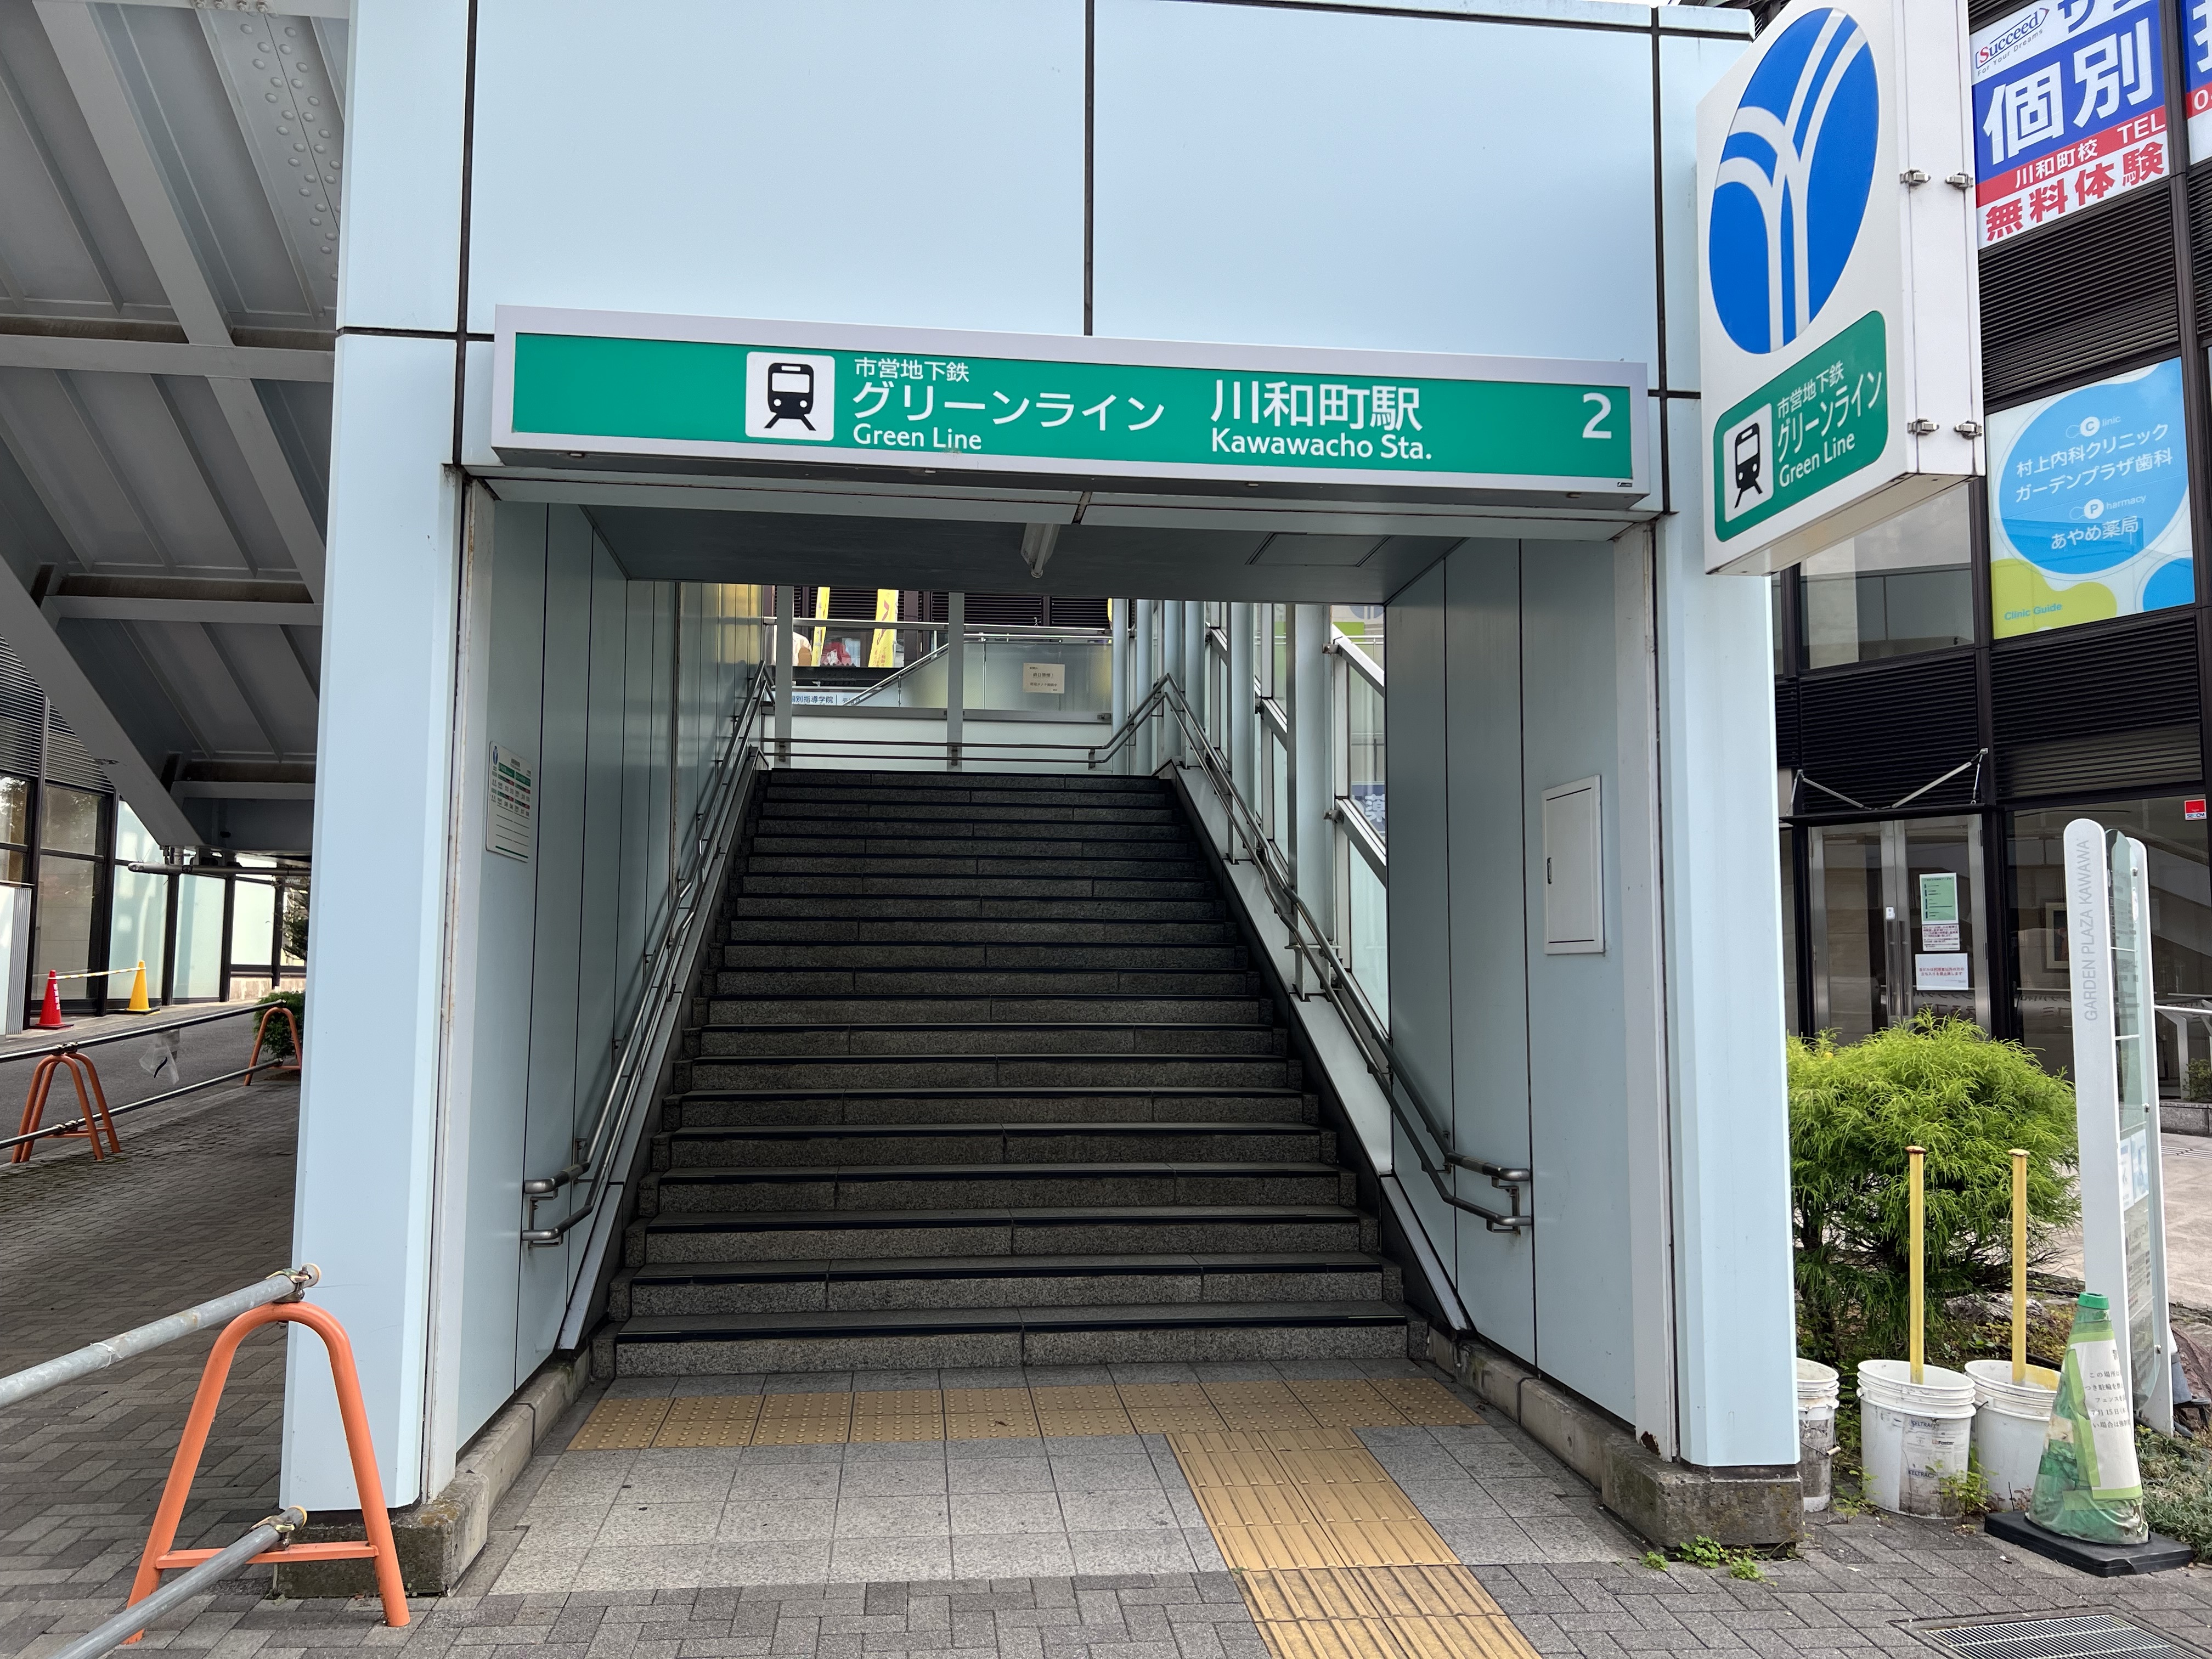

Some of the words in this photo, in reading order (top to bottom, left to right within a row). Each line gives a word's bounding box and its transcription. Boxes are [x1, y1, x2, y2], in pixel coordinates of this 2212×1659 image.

[1977, 65, 1990, 77] For
[1993, 51, 2010, 65] Your
[2013, 29, 2043, 52] Dreams
[1979, 10, 2039, 63] Succeed
[1983, 18, 2154, 165] 個別
[2015, 139, 2098, 189] 川和町校
[2117, 113, 2166, 144] TEL
[1985, 141, 2165, 241] 無料体験
[854, 357, 970, 382] 市営地下鉄
[1777, 360, 1844, 419] 市営地下鉄
[852, 381, 1164, 432] グリーンライン
[1210, 379, 1423, 432] 川和町駅
[1582, 393, 1613, 439] 2
[853, 423, 925, 448] Green
[933, 427, 982, 450] Line
[1778, 371, 1882, 463] グリーンライン
[1212, 428, 1373, 458] Kawawacho
[1381, 434, 1432, 460] Sta.
[1779, 452, 1820, 488] Green
[1824, 433, 1855, 464] Line
[2016, 424, 2168, 478] 村上内科クリニック
[2016, 447, 2173, 503] ガーデンプラザ歯科
[2051, 515, 2138, 550] あやめ薬局
[2004, 610, 2030, 620] Clinic
[2033, 603, 2062, 616] Guide
[2077, 839, 2092, 905] KAWAWA
[2080, 909, 2095, 955] PLAZA
[2084, 960, 2098, 1022] GARDEN
